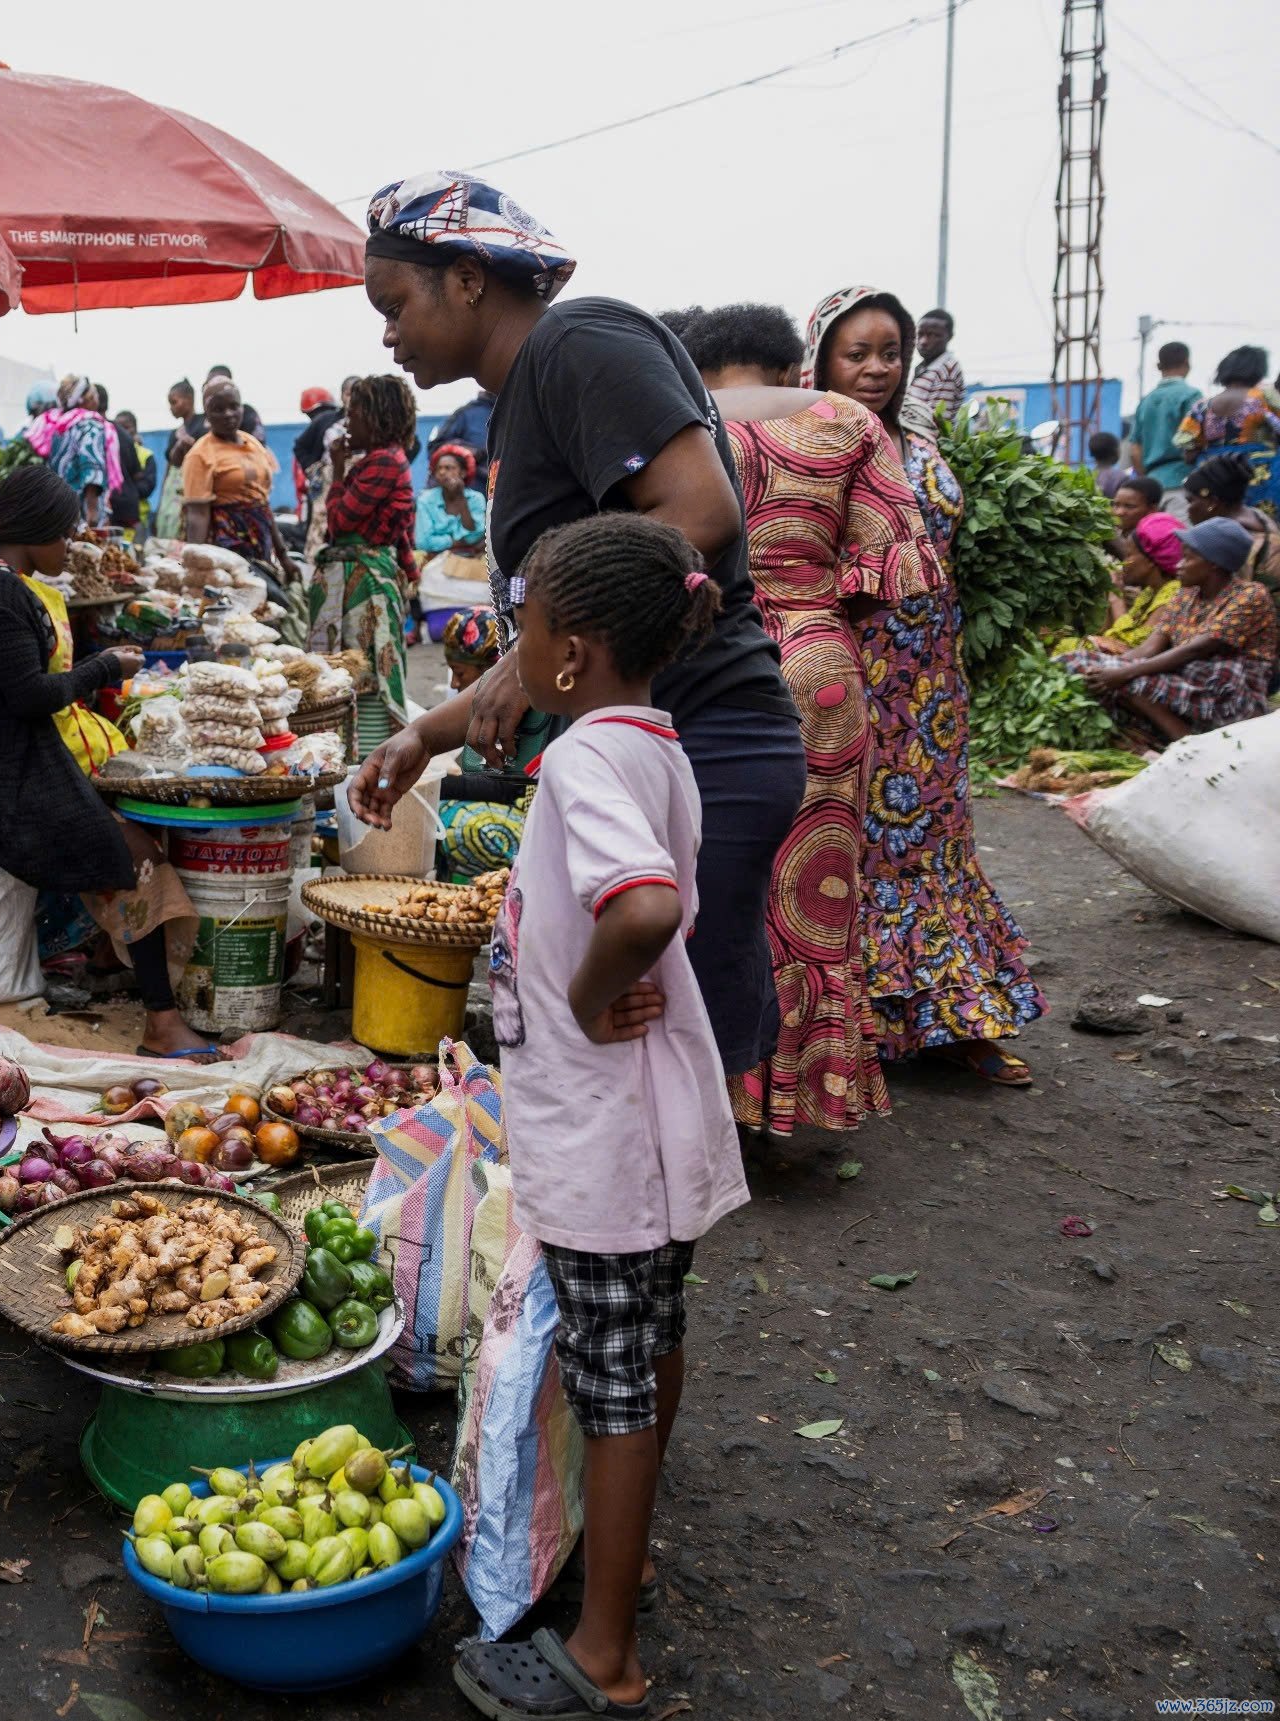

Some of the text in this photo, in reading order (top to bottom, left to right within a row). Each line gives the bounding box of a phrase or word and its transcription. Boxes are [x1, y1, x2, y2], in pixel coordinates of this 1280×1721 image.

[9, 230, 207, 249] THE SMARTPHONE NETWORK
[207, 863, 282, 874] PAINTS
